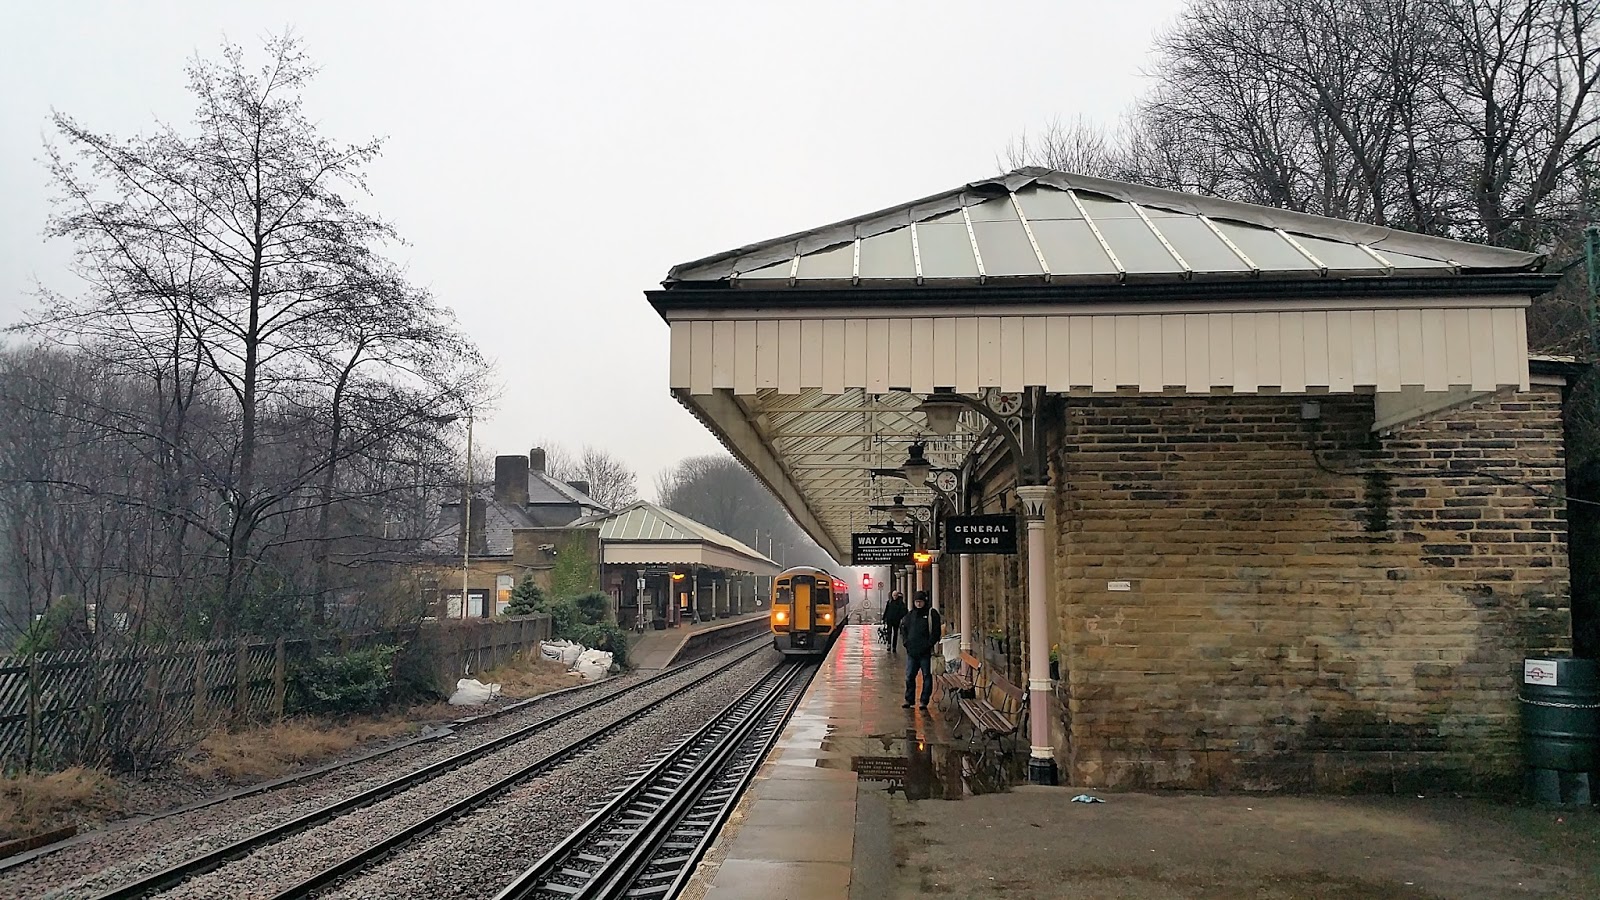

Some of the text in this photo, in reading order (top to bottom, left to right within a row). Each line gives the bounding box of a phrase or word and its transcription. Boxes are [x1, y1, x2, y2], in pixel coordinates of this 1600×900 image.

[954, 525, 1009, 533] GENERAL
[858, 536, 903, 545] WAY OUT
[965, 536, 998, 545] ROOM
